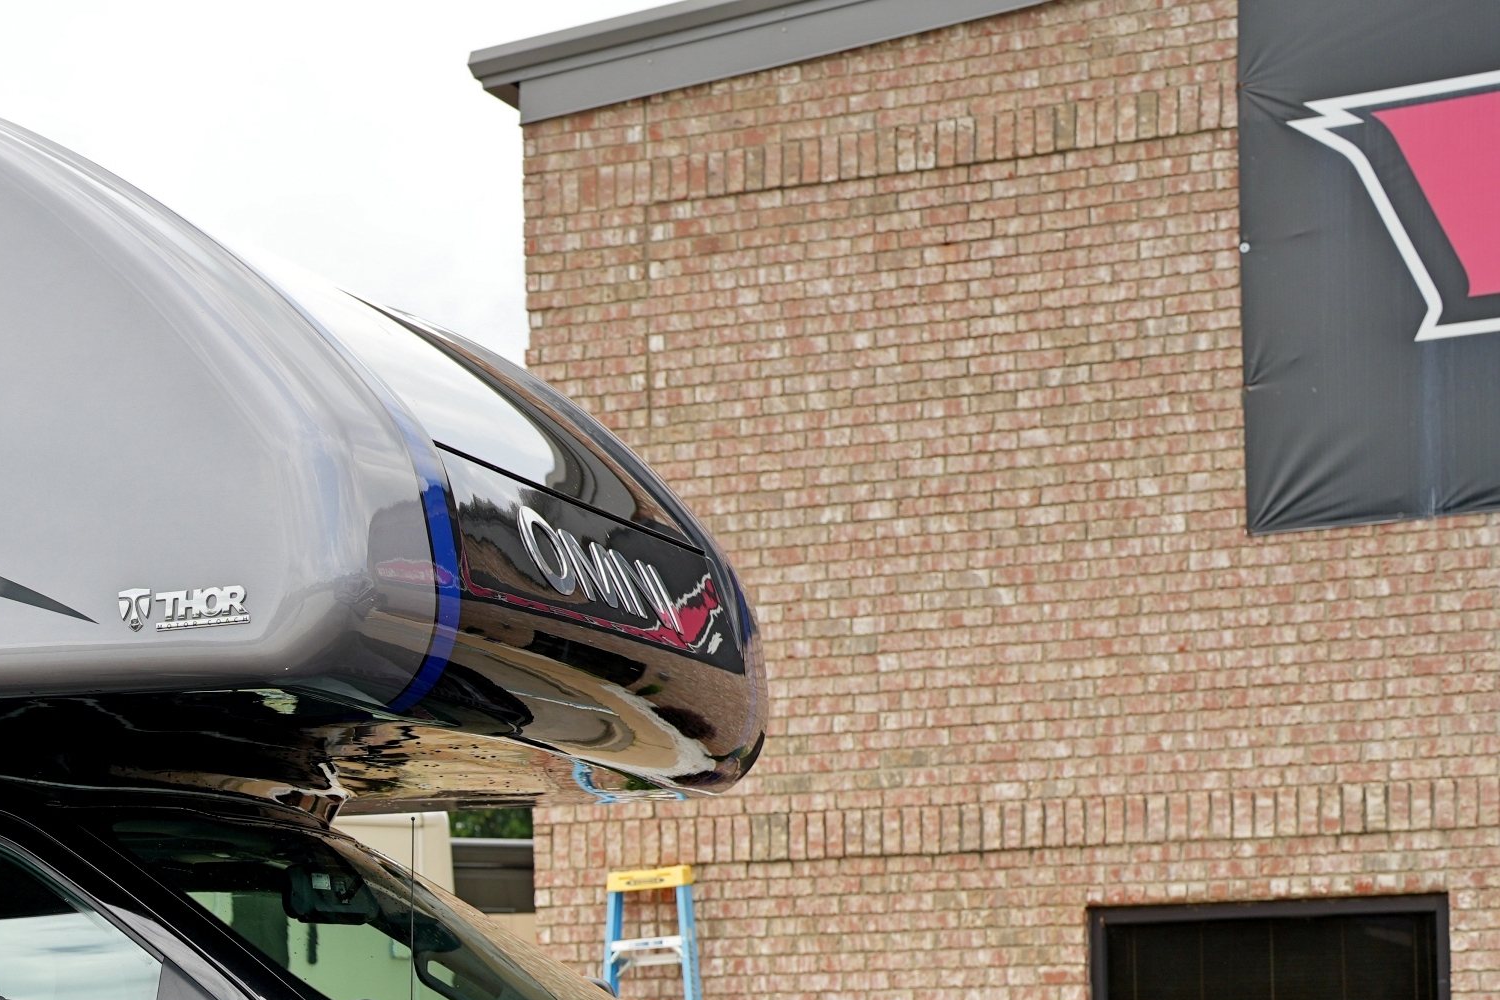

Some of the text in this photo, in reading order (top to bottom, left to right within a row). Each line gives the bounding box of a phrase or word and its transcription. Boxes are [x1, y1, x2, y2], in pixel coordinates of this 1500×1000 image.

[516, 505, 684, 635] OMNI
[155, 585, 249, 621] THOR
[157, 616, 248, 630] MOTOR COACH
